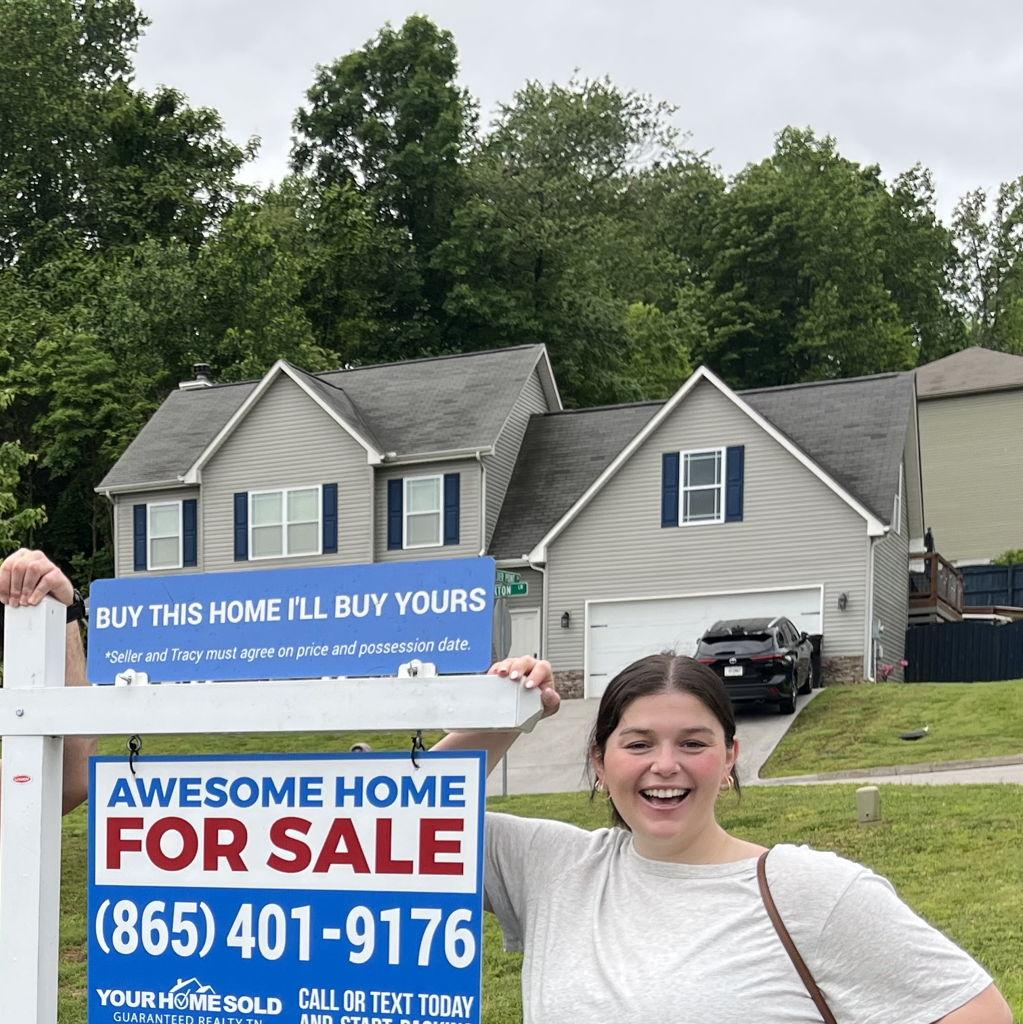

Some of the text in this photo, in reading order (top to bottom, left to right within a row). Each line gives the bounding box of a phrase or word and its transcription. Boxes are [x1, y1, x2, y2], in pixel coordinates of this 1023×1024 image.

[96, 587, 486, 629] BUY THIS HOME I'LL BUY YOURS
[147, 648, 167, 662] and
[171, 648, 204, 664] Tracy
[206, 647, 237, 660] must
[240, 646, 275, 662] agree
[278, 647, 294, 658] on
[296, 642, 329, 660] price
[331, 640, 357, 655] and
[358, 638, 435, 658] possession
[438, 637, 470, 652] date.
[107, 775, 466, 808] AWESOME HOME
[106, 816, 464, 875] FOR SALE
[95, 899, 476, 968] (865) 401-9176
[96, 989, 156, 1008] YOUR
[223, 995, 282, 1015] SOLD
[299, 988, 474, 1018] CALL OR TEXT TODAY
